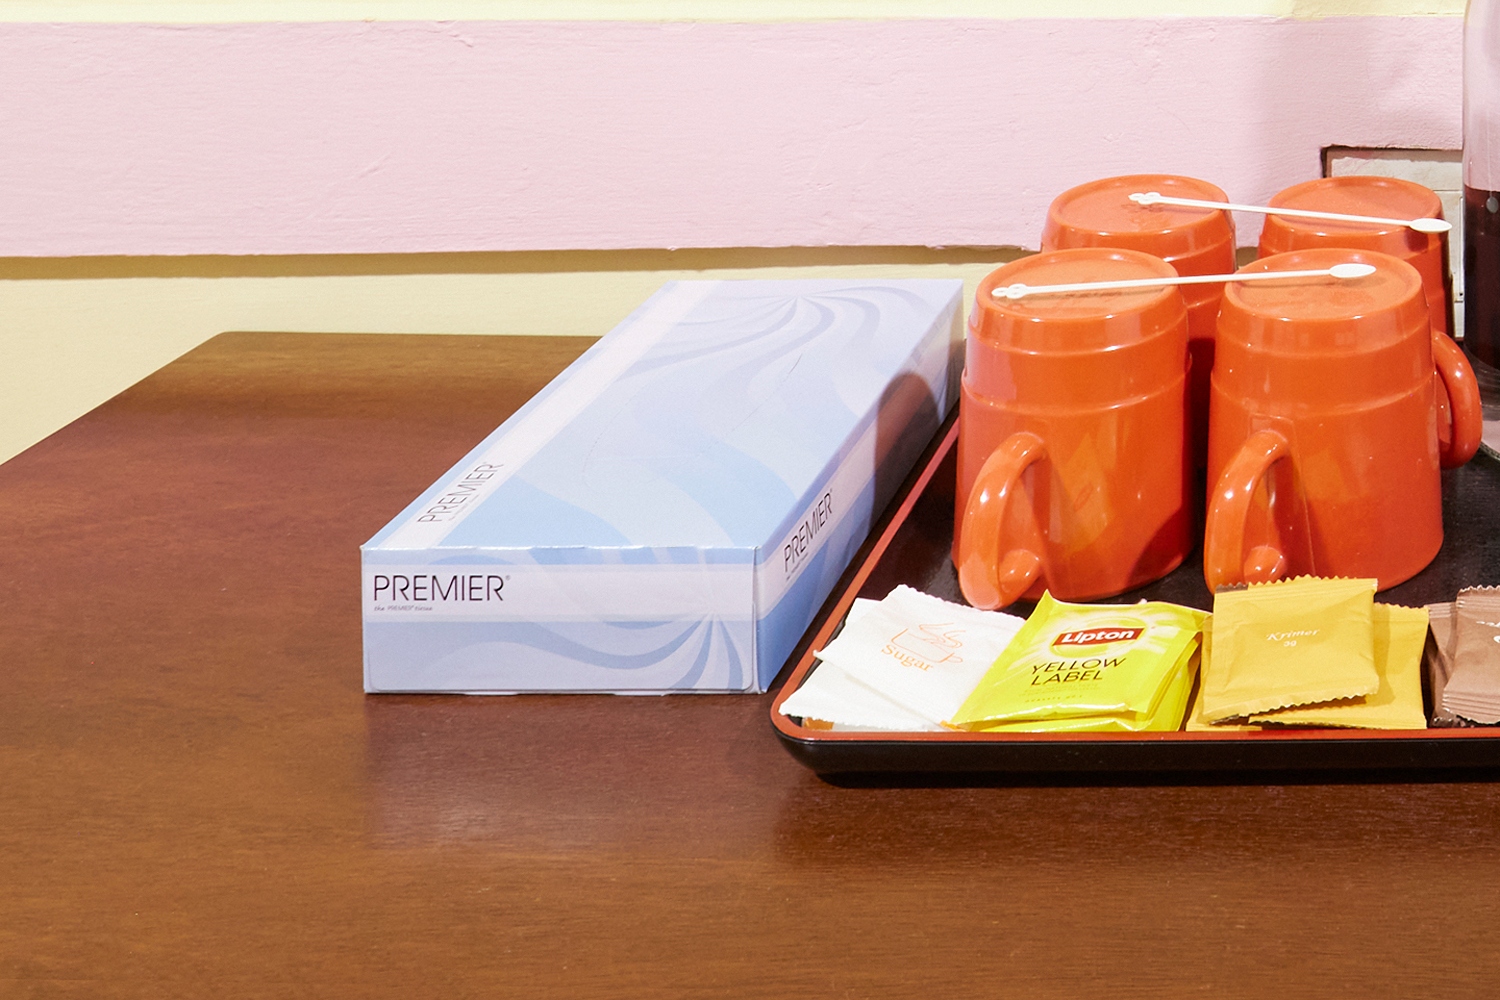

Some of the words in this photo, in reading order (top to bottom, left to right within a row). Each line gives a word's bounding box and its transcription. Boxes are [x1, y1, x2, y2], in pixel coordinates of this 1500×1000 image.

[417, 463, 504, 522] PREMIER
[783, 492, 833, 573] PREMIER
[373, 574, 504, 601] PREMIER
[1061, 630, 1135, 643] Lipton
[881, 644, 934, 671] Sugar
[1031, 657, 1127, 674] YELLOW
[1030, 670, 1103, 686] LABEL
